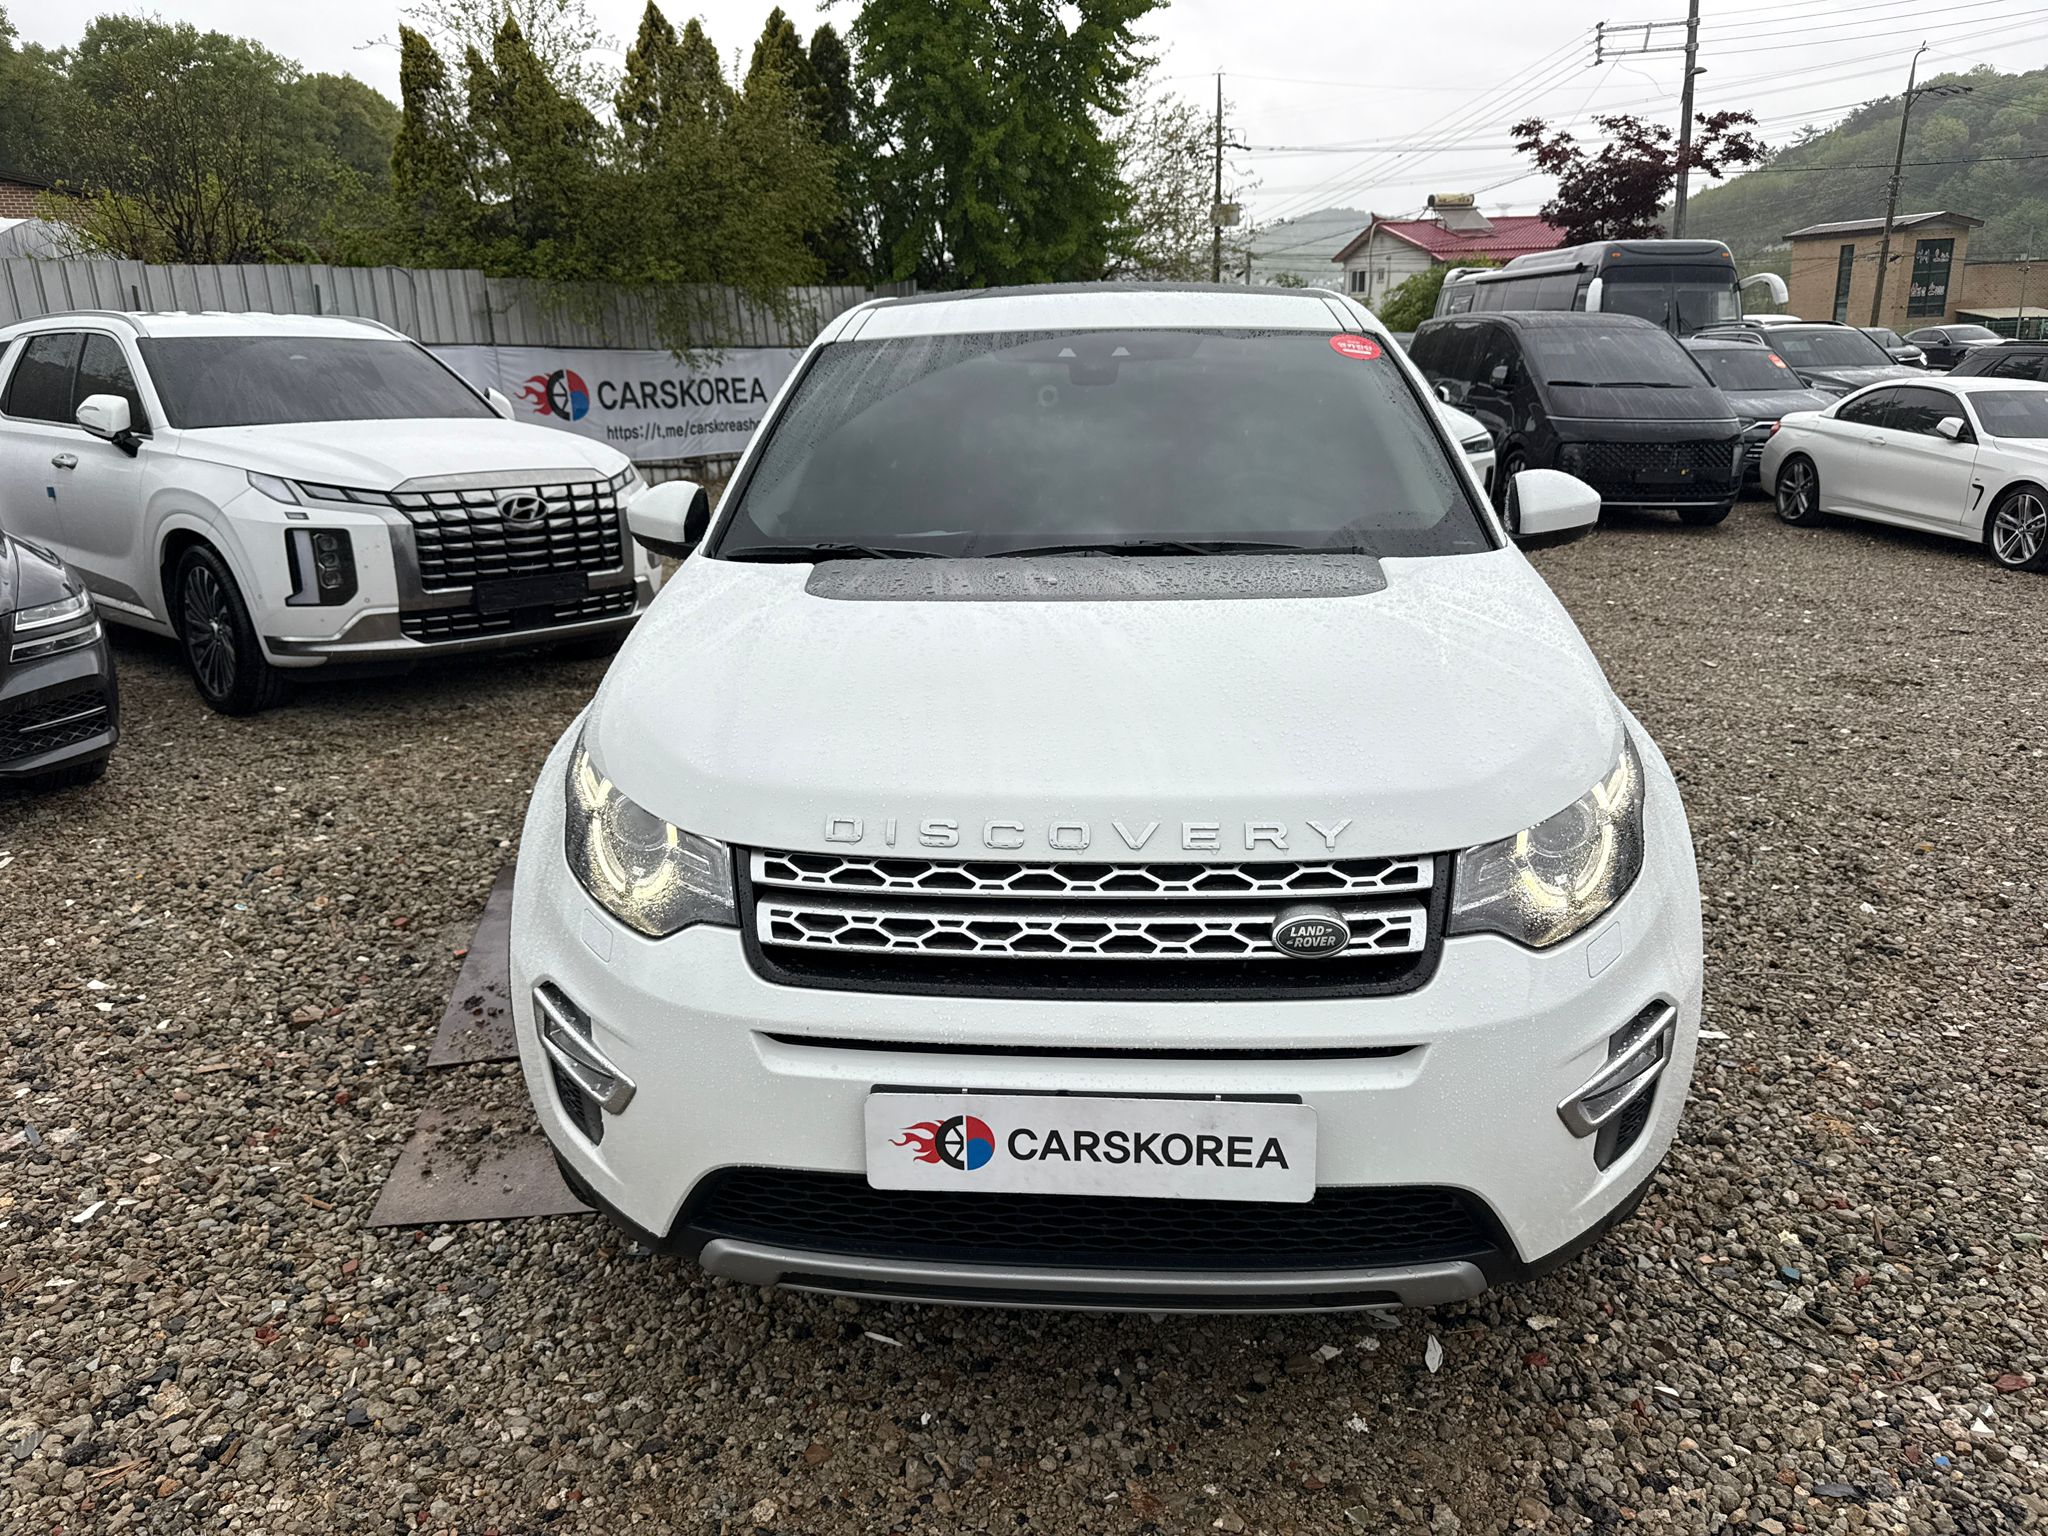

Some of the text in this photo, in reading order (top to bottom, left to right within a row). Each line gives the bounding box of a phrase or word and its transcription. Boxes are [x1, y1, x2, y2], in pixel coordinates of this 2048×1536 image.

[597, 377, 768, 410] CARSKOREA
[825, 814, 1353, 850] DISCOVERY
[1290, 925, 1325, 937] LAND
[1293, 936, 1336, 948] ROVER
[1007, 1127, 1290, 1170] CARSKOREA
